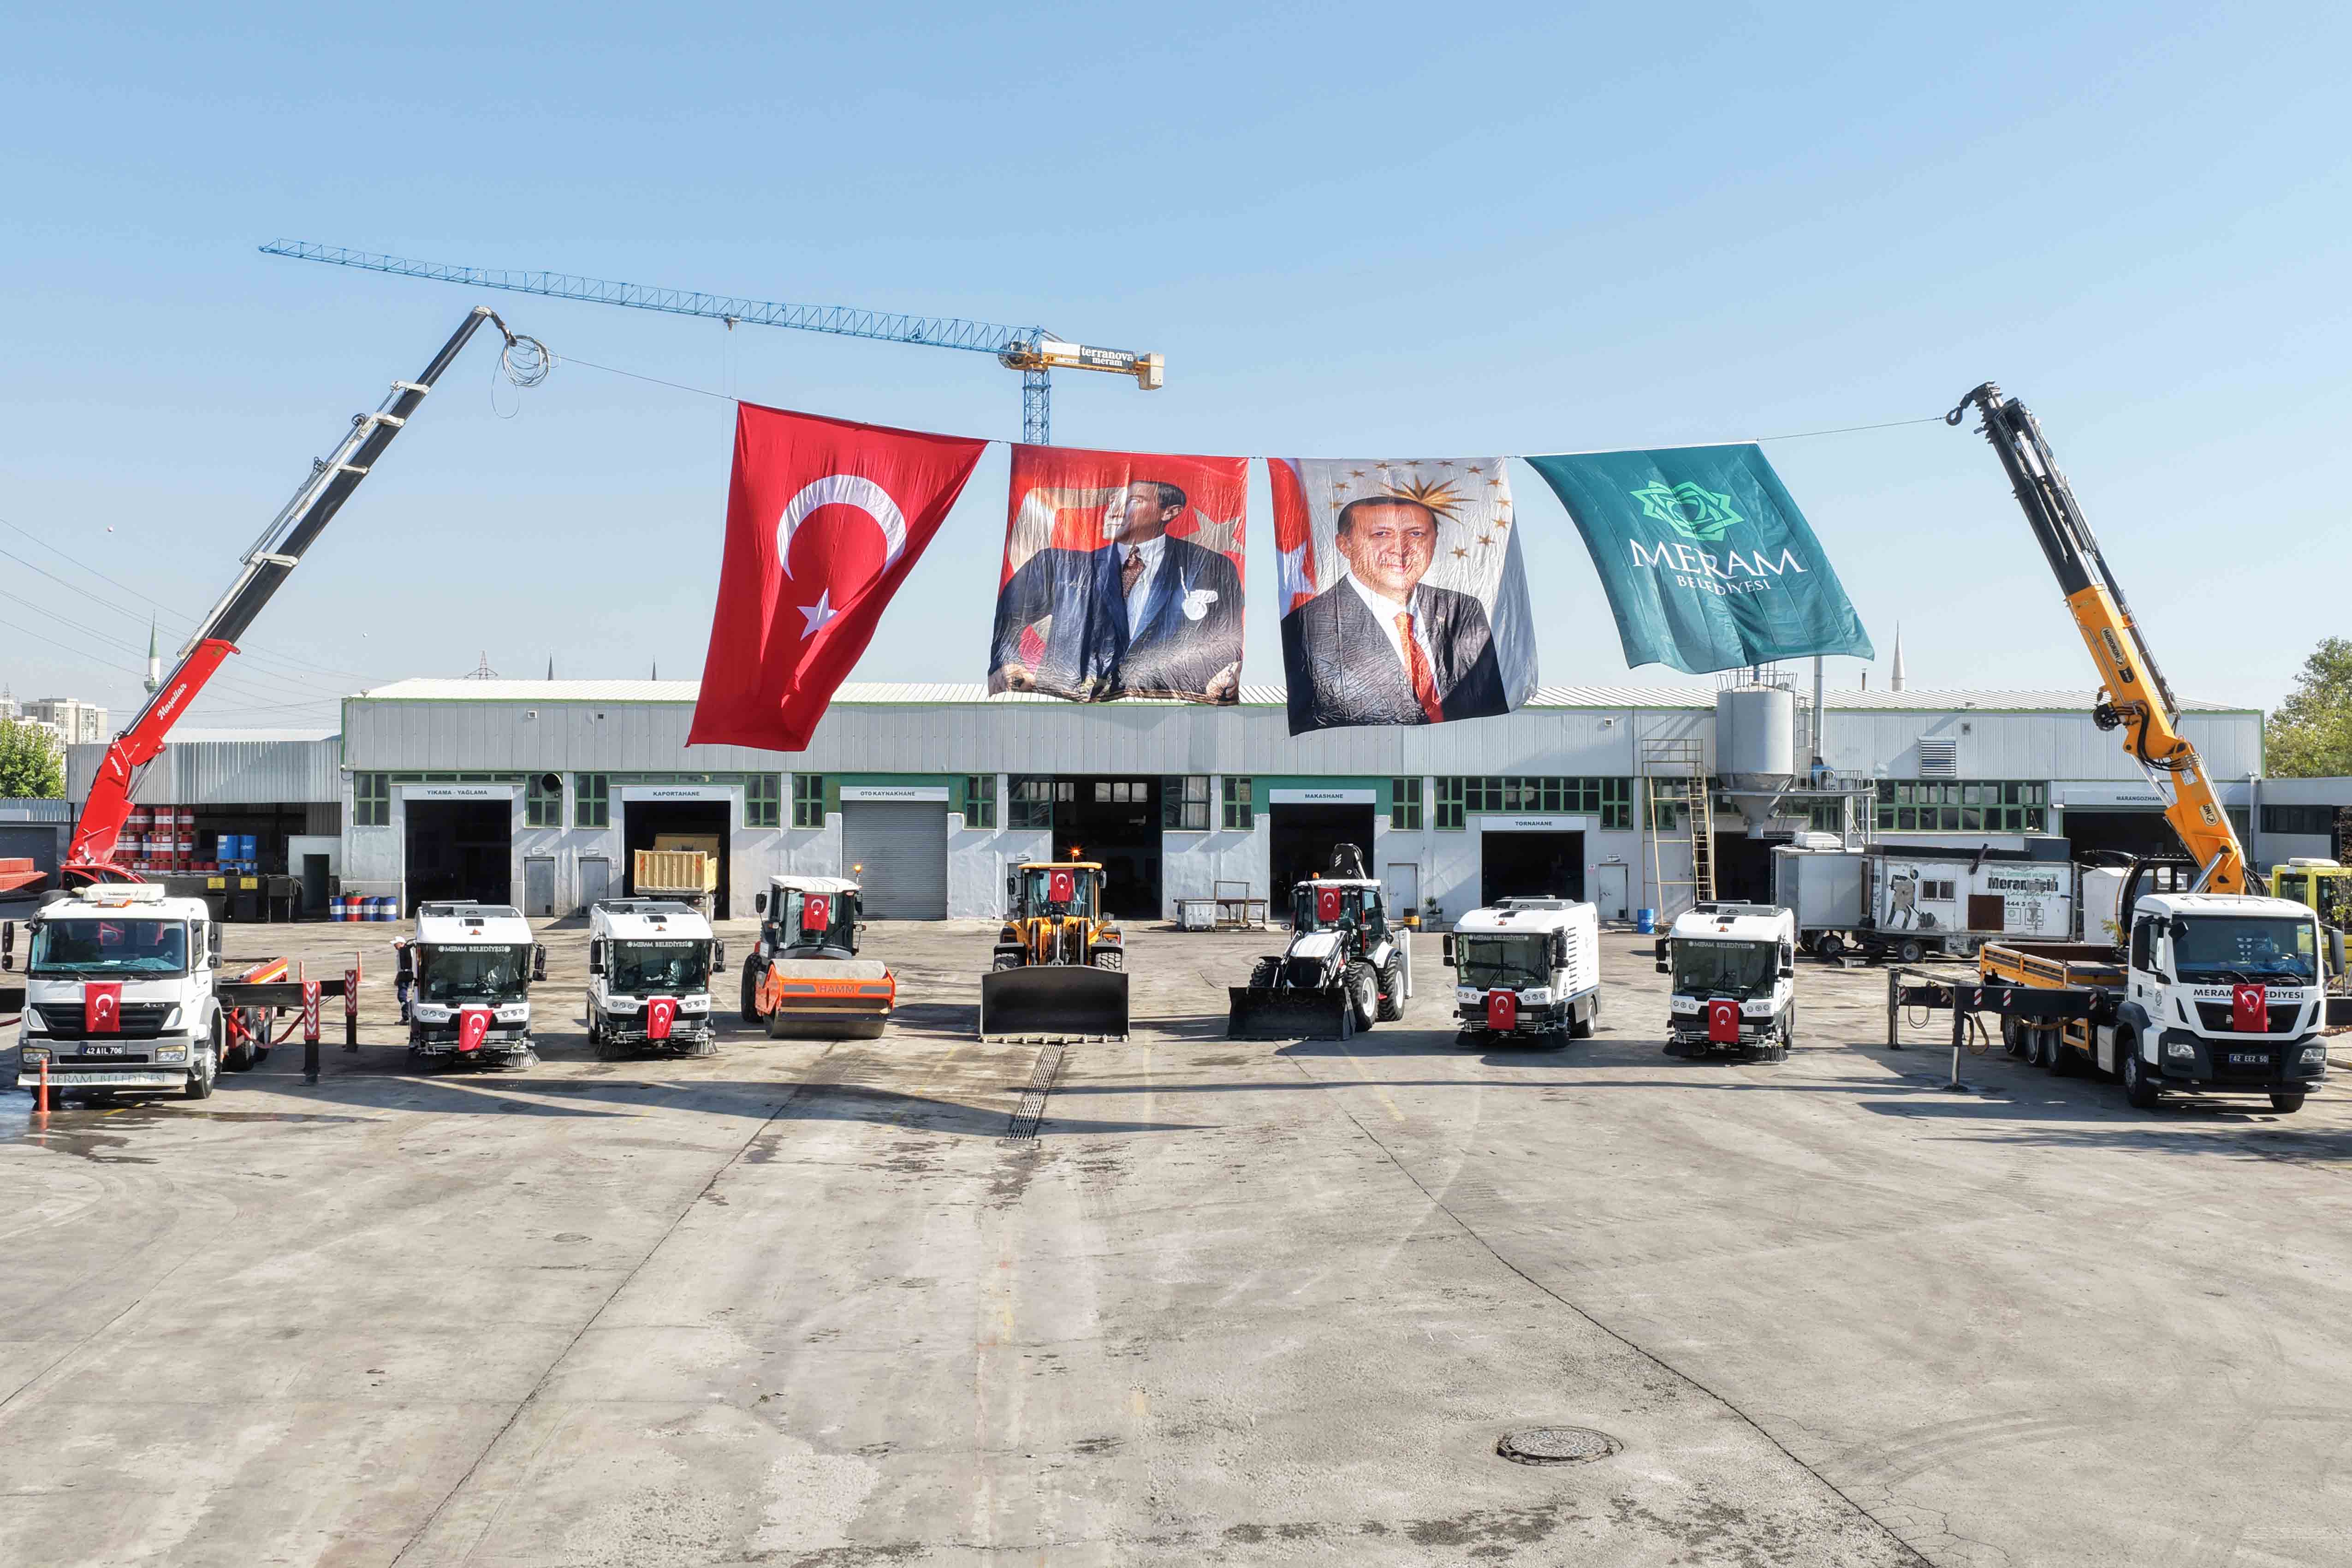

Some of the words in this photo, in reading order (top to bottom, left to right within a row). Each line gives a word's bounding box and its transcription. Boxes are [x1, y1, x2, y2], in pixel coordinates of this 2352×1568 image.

[1081, 346, 1134, 362] terranova
[1092, 357, 1123, 367] meram
[1629, 538, 1808, 579] MERAM
